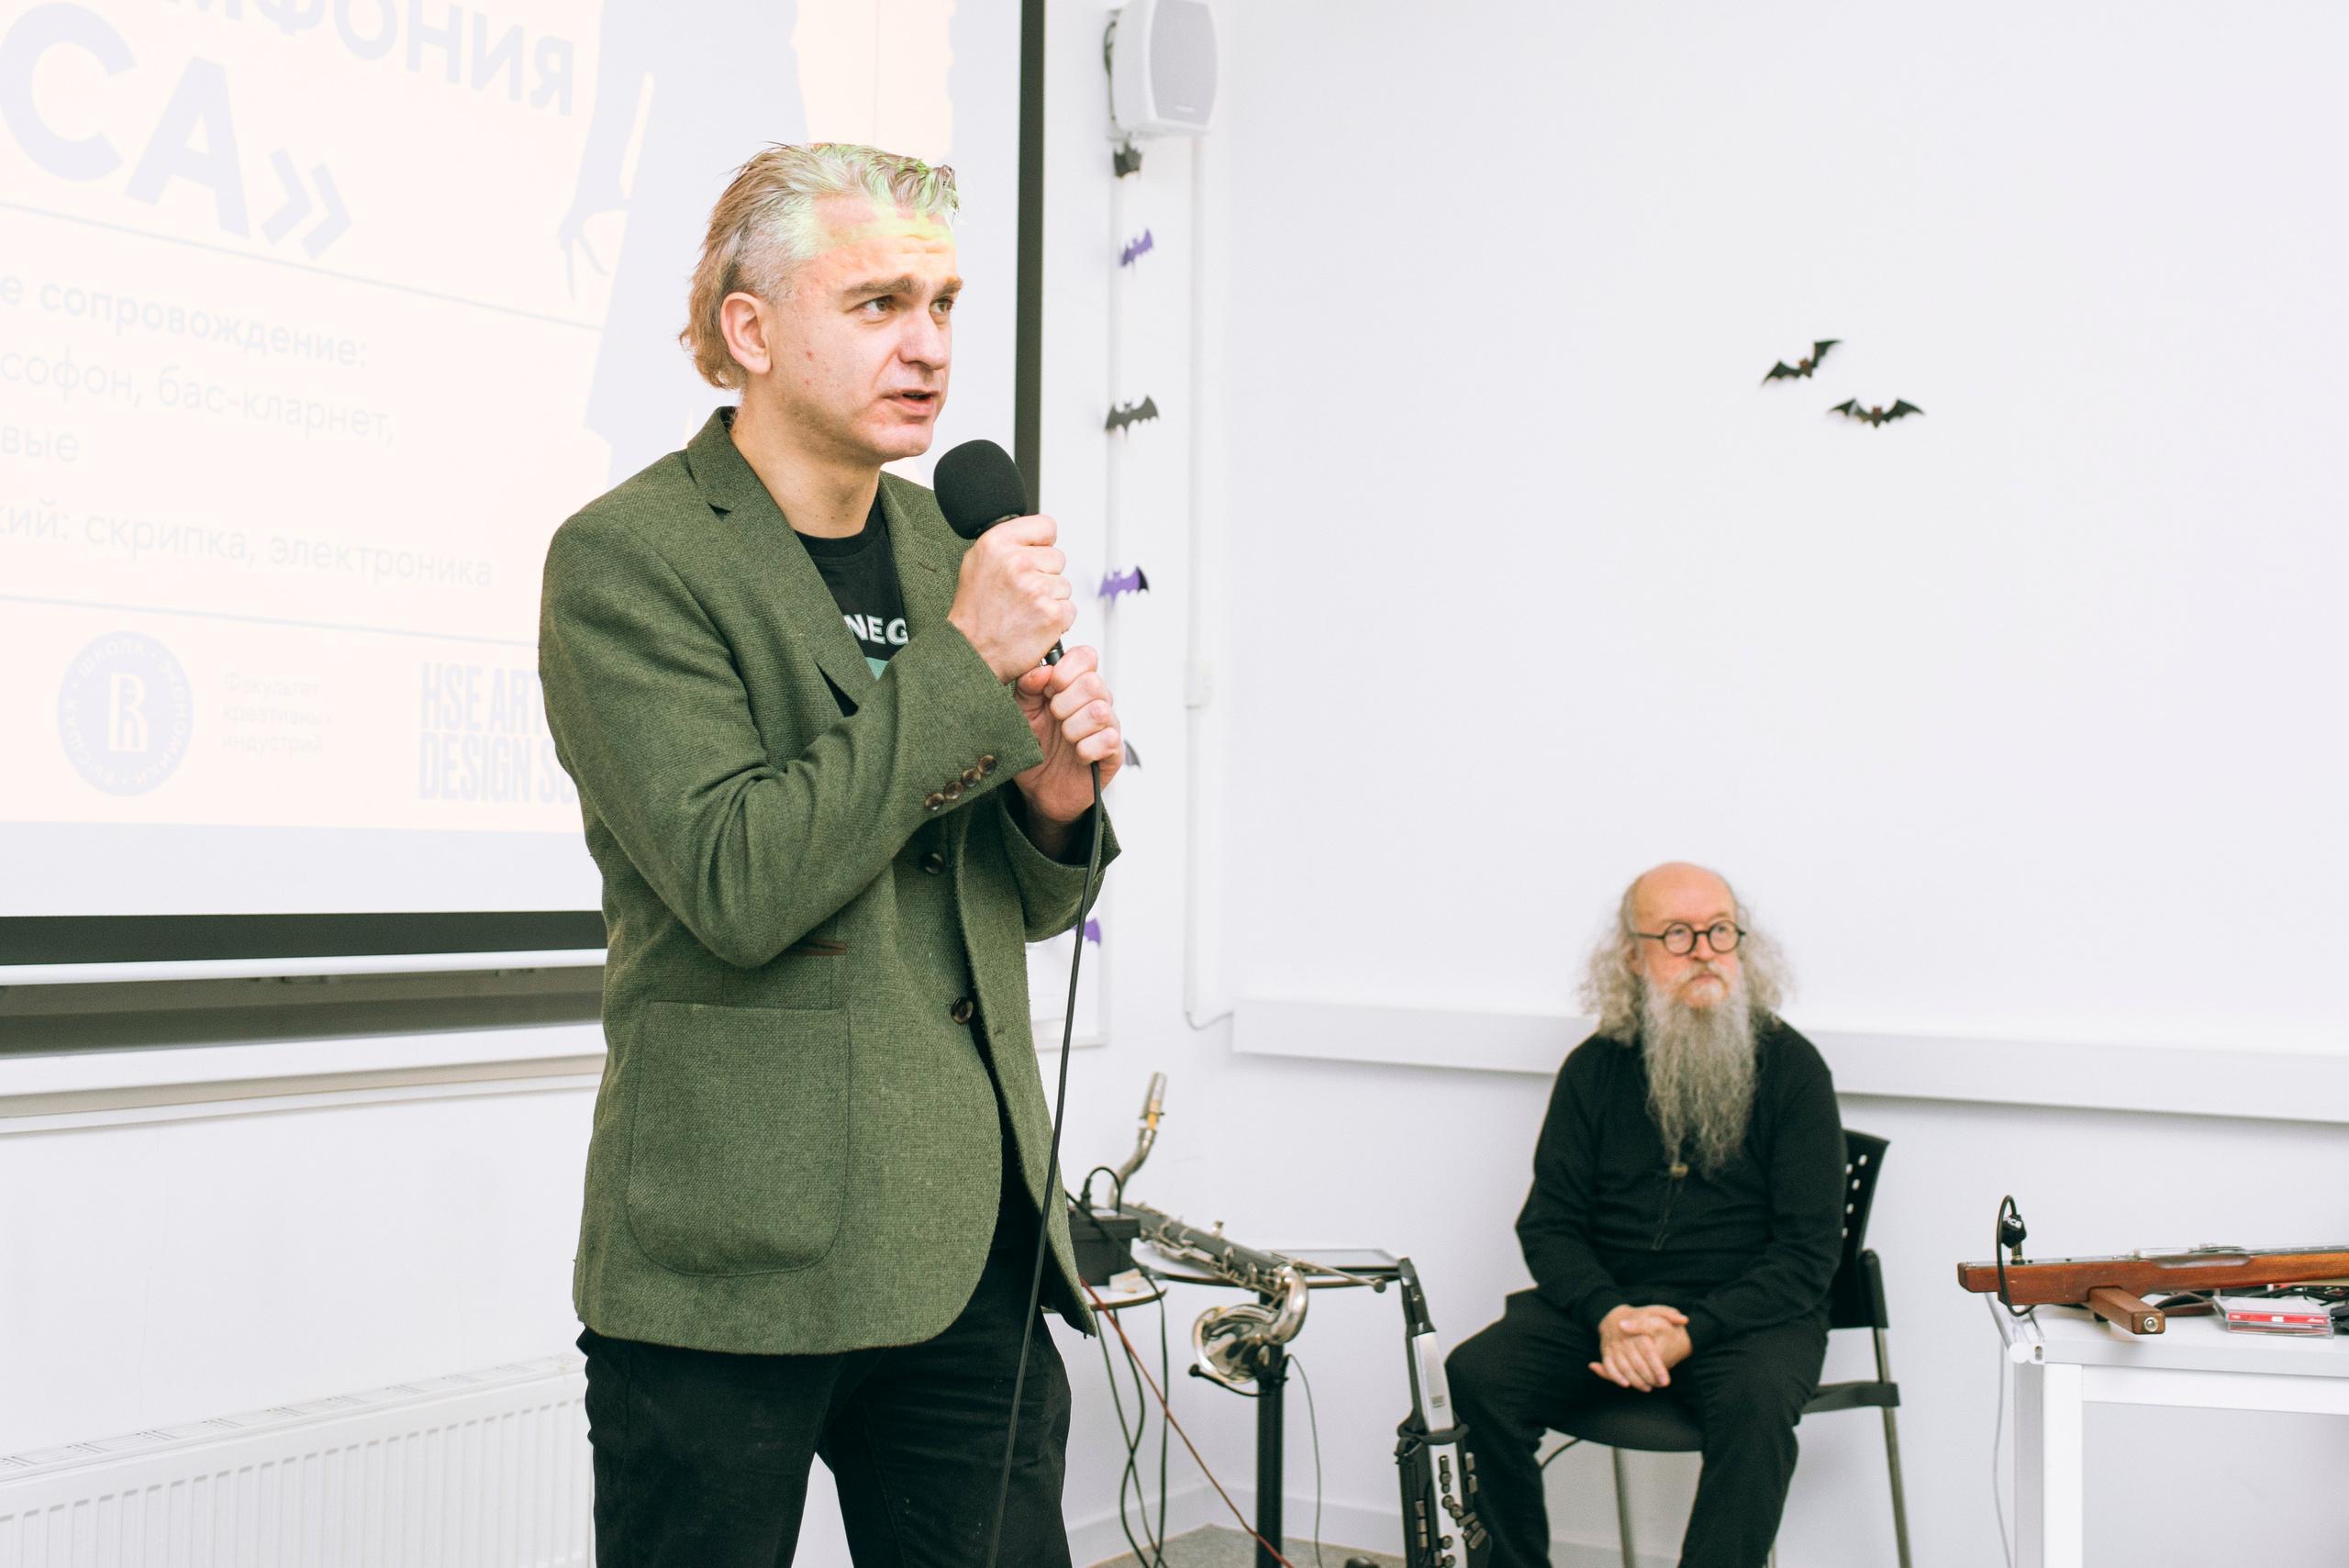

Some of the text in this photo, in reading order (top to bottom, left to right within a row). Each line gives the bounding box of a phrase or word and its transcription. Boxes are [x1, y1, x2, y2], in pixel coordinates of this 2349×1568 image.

[167, 0, 574, 117] ОНИЯ
[39, 282, 367, 367] сопровождение:
[0, 343, 395, 445] софон, бас-кларнет,
[2, 424, 80, 462] вые
[0, 498, 492, 587] ий: скрипка, электроника
[224, 671, 321, 699] Факультет
[421, 661, 545, 735] HSE ART
[418, 731, 532, 804] DESIGN
